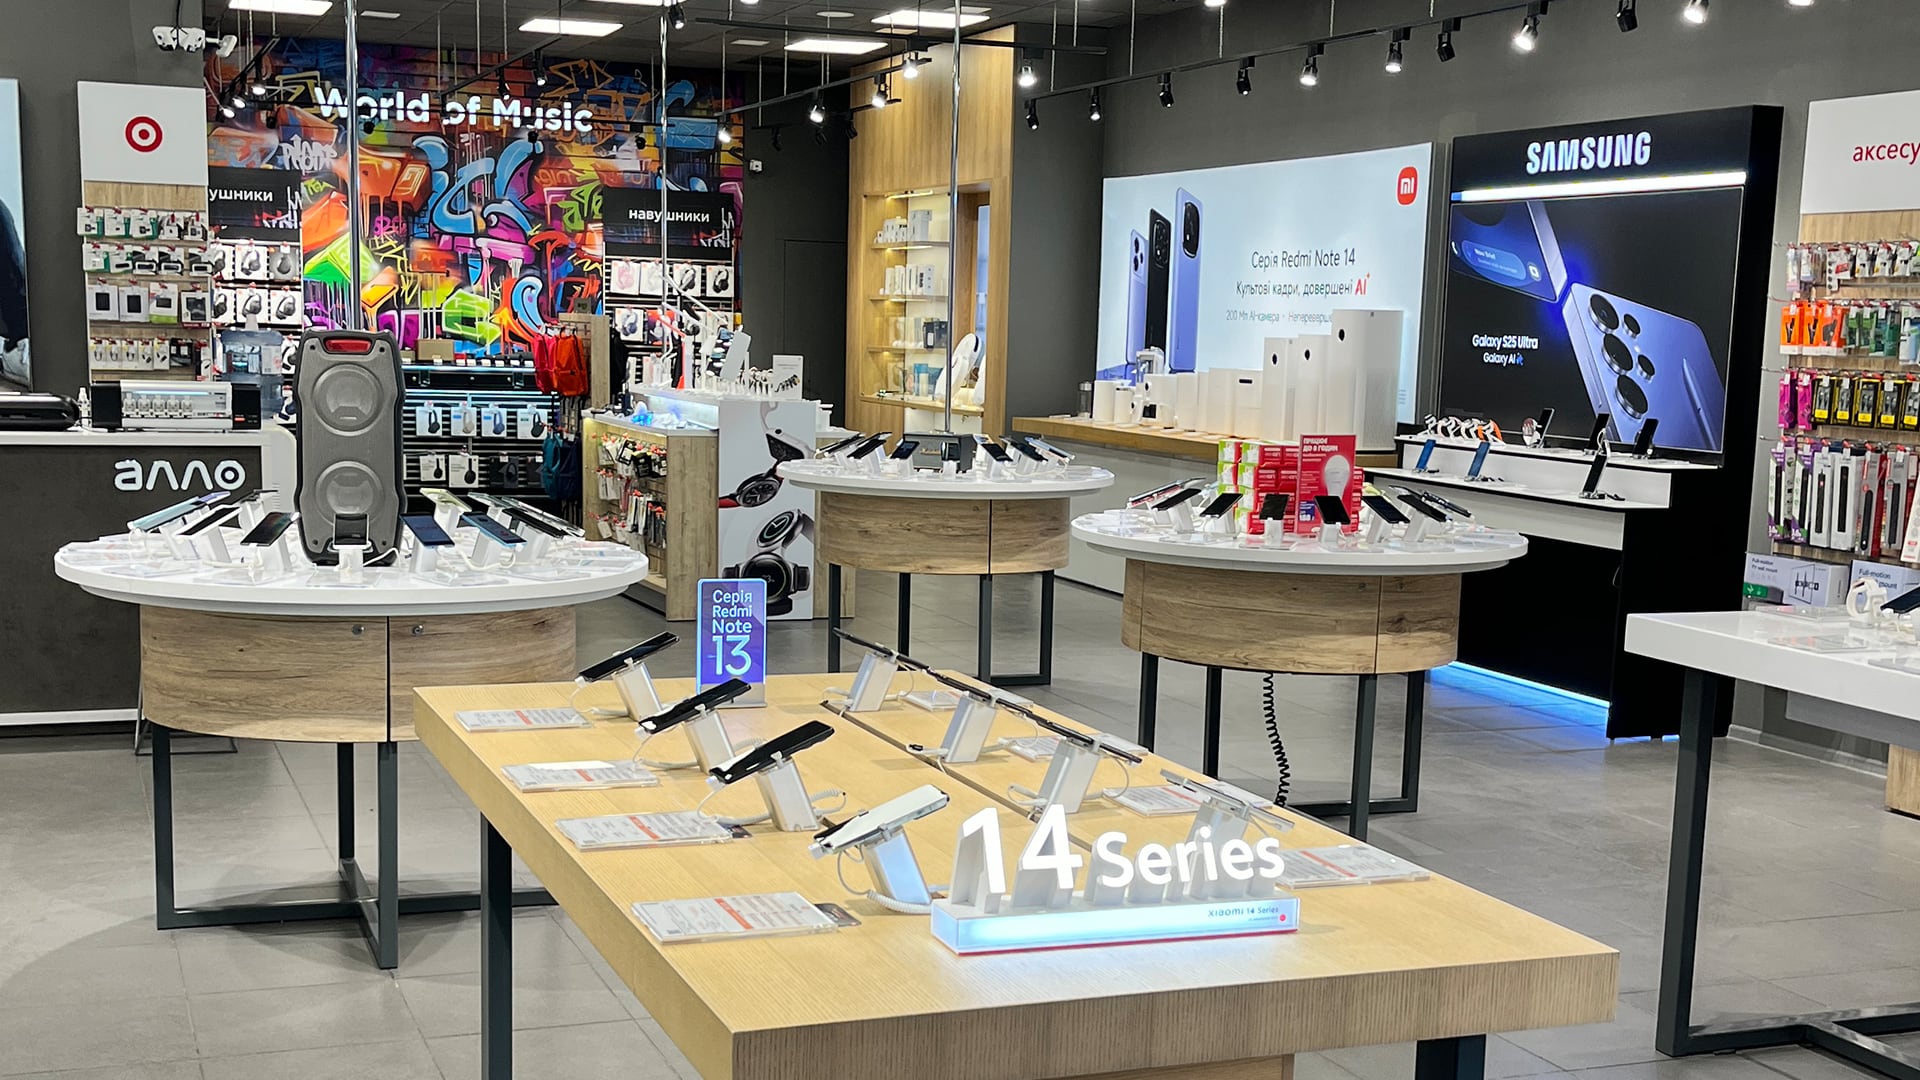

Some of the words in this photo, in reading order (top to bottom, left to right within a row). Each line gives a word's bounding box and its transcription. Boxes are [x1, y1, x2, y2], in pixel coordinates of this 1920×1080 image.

[315, 86, 430, 124] World
[443, 95, 481, 125] of
[493, 97, 594, 133] Music
[1525, 131, 1651, 175] SAMSUNG
[1853, 142, 1920, 165] аксесу
[628, 209, 710, 223] навушники
[1251, 250, 1279, 272] Серія
[1281, 249, 1312, 268] Redmi
[1314, 249, 1341, 267] Note
[1343, 248, 1356, 266] 14
[1236, 280, 1271, 299] Культові
[1302, 279, 1353, 299] довершені
[1354, 278, 1367, 296] AI
[1226, 309, 1238, 321] 200
[1472, 334, 1502, 351] Galaxy
[1502, 335, 1517, 349] S25
[1517, 335, 1539, 349] Ultra
[1483, 352, 1508, 367] Galaxy
[1508, 353, 1516, 364] AI
[1858, 568, 1892, 580] Full-motion
[712, 589, 753, 606] Серія
[712, 605, 753, 618] Redmi
[712, 618, 753, 634] Note
[712, 634, 752, 676] 13
[962, 804, 1083, 894] 14
[1096, 825, 1286, 889] Series
[1246, 907, 1255, 915] 14
[1257, 905, 1279, 914] Series
